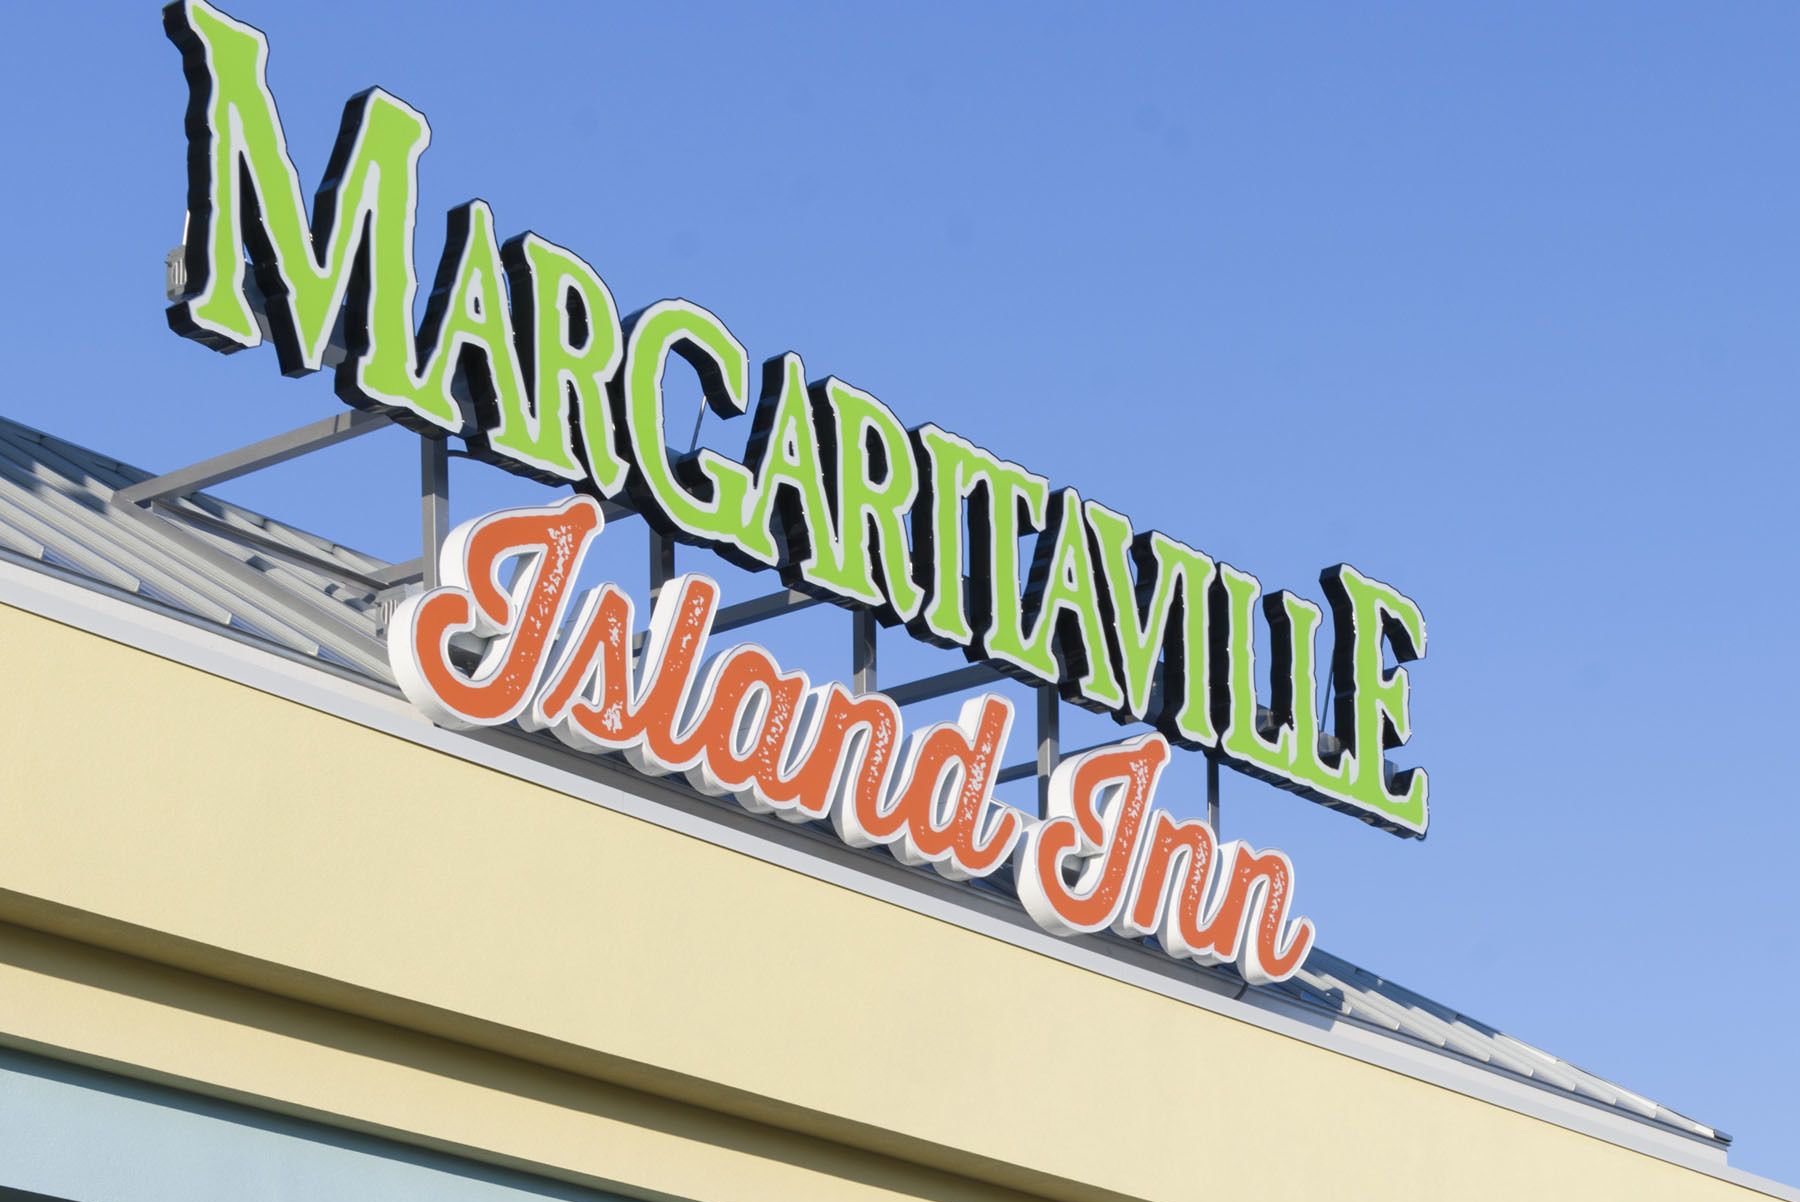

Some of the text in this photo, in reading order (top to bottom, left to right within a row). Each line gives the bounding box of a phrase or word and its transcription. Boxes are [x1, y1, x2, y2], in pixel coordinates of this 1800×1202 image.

[166, 0, 1430, 839] MARGARITAVILLE
[395, 495, 1315, 984] Island Inn
